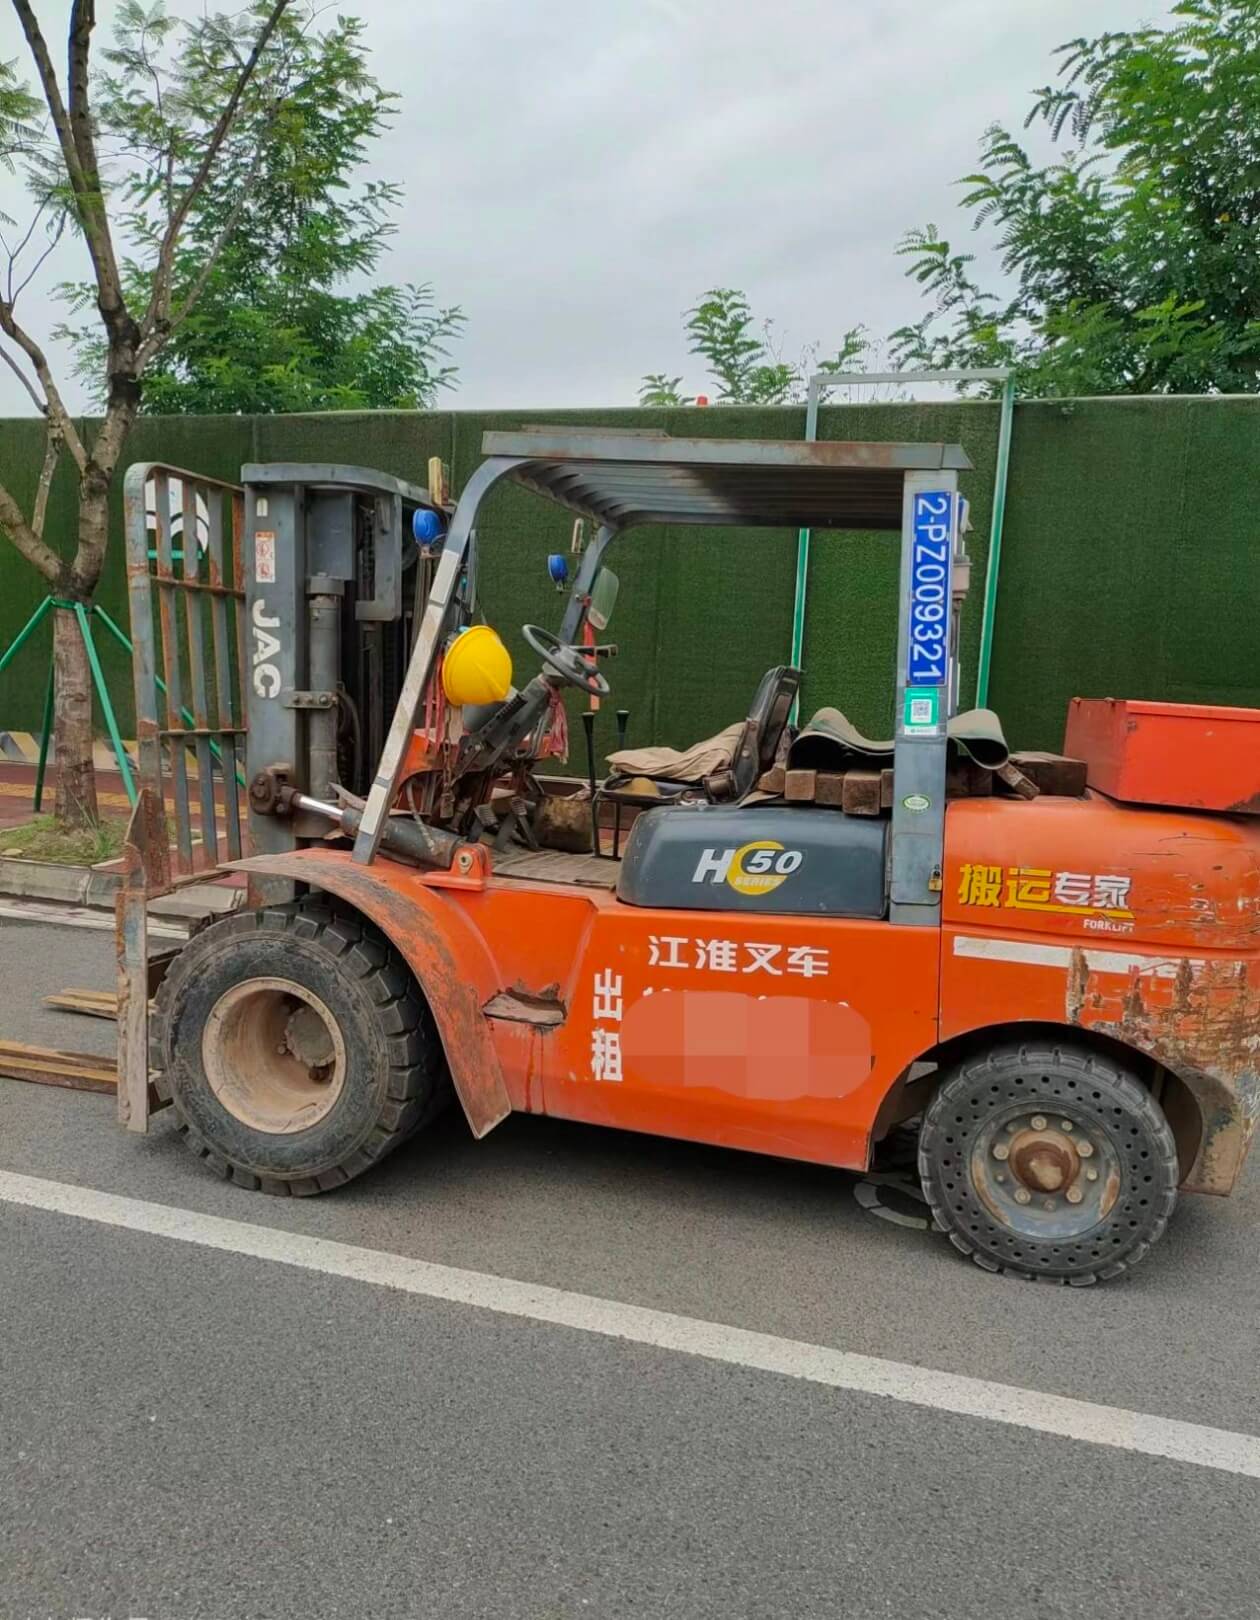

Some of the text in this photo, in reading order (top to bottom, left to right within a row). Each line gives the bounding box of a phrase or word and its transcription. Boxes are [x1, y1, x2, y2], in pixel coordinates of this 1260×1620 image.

[913, 498, 948, 680] 2-PZ009321
[251, 598, 282, 699] JAC
[958, 863, 1132, 911] 搬运专家
[648, 935, 830, 978] 江淮叉车
[1083, 918, 1135, 933] FORKLIFT
[591, 967, 624, 1082] 出租
